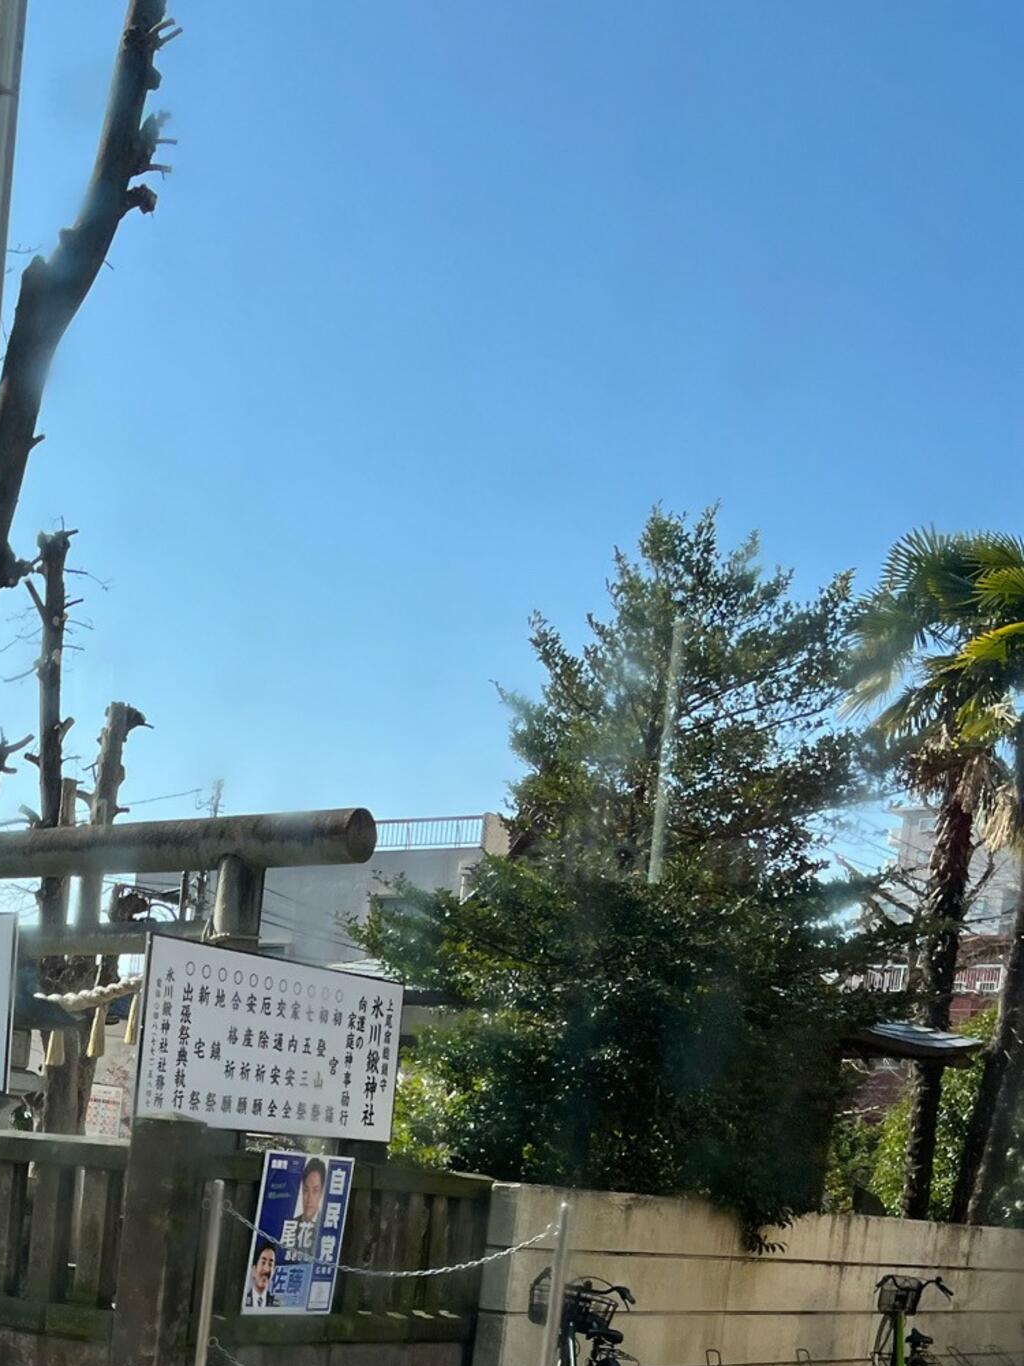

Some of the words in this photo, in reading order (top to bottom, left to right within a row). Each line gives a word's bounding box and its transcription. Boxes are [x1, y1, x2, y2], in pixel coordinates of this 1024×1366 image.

[281, 1220, 314, 1248] 尾花
[319, 1168, 346, 1262] 自民党
